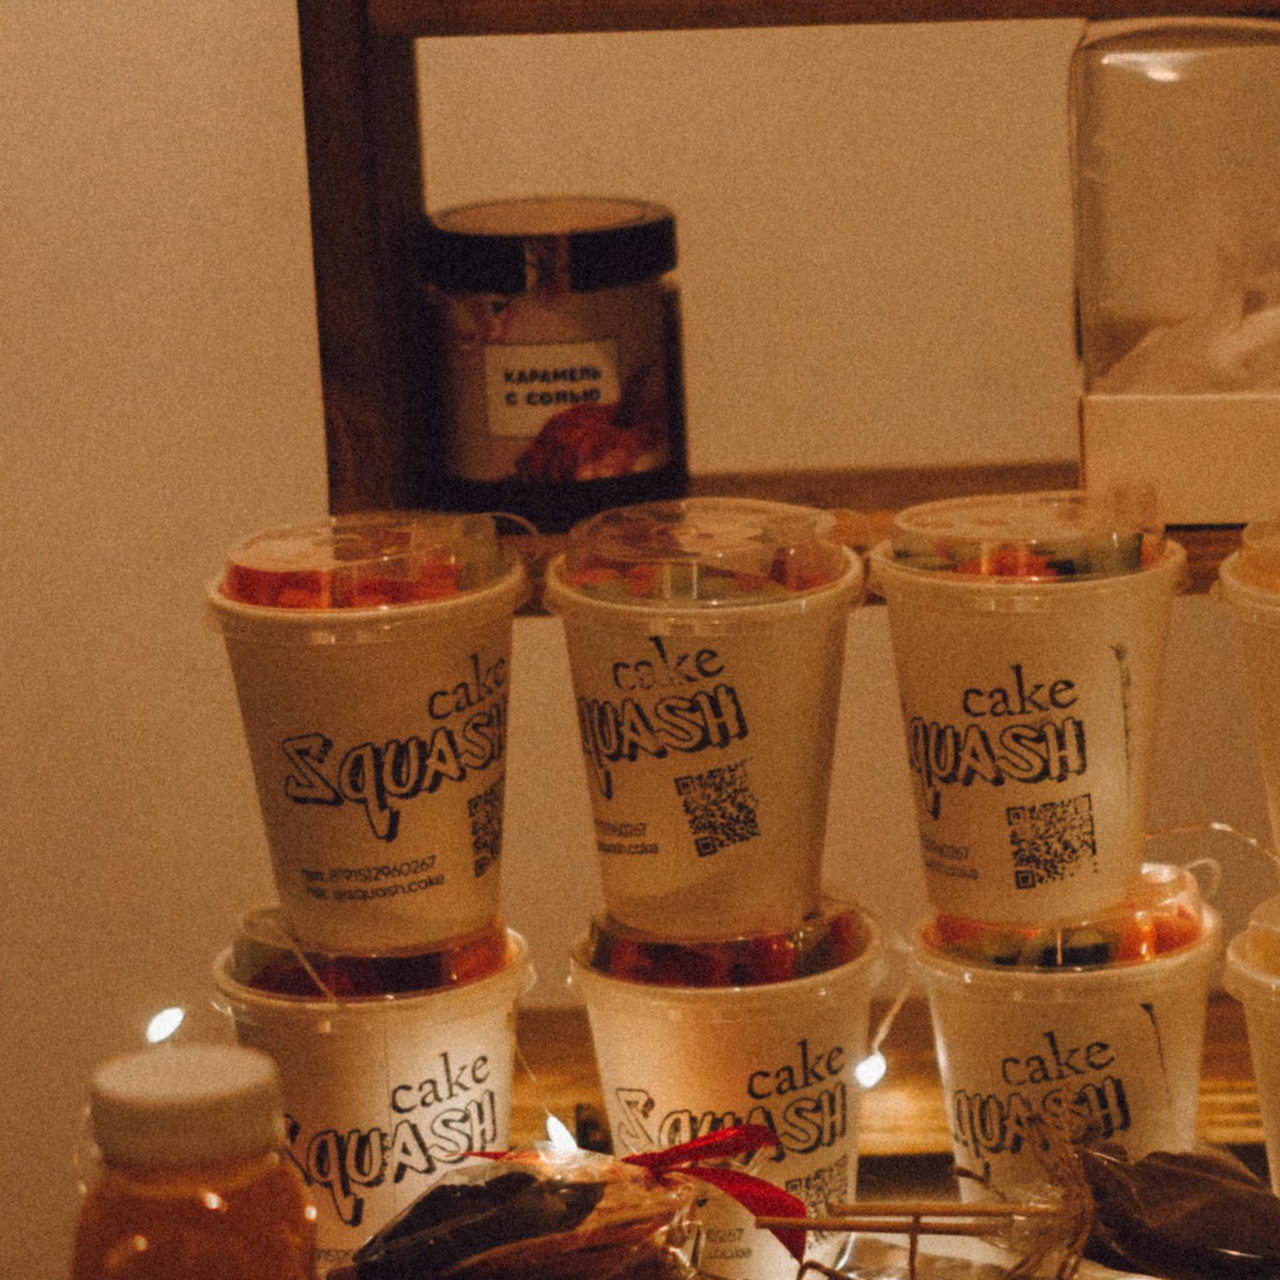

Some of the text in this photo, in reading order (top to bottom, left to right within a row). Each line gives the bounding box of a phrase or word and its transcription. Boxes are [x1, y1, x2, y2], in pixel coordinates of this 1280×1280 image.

[504, 366, 601, 384] КАРАМЕЛЬ
[505, 388, 601, 406] С СОЛЬЮ
[428, 653, 506, 720] cake
[613, 635, 725, 691] cake
[963, 663, 1079, 718] cake
[391, 1050, 491, 1115] cake
[747, 1037, 846, 1101] cake
[1002, 1030, 1116, 1087] cake
